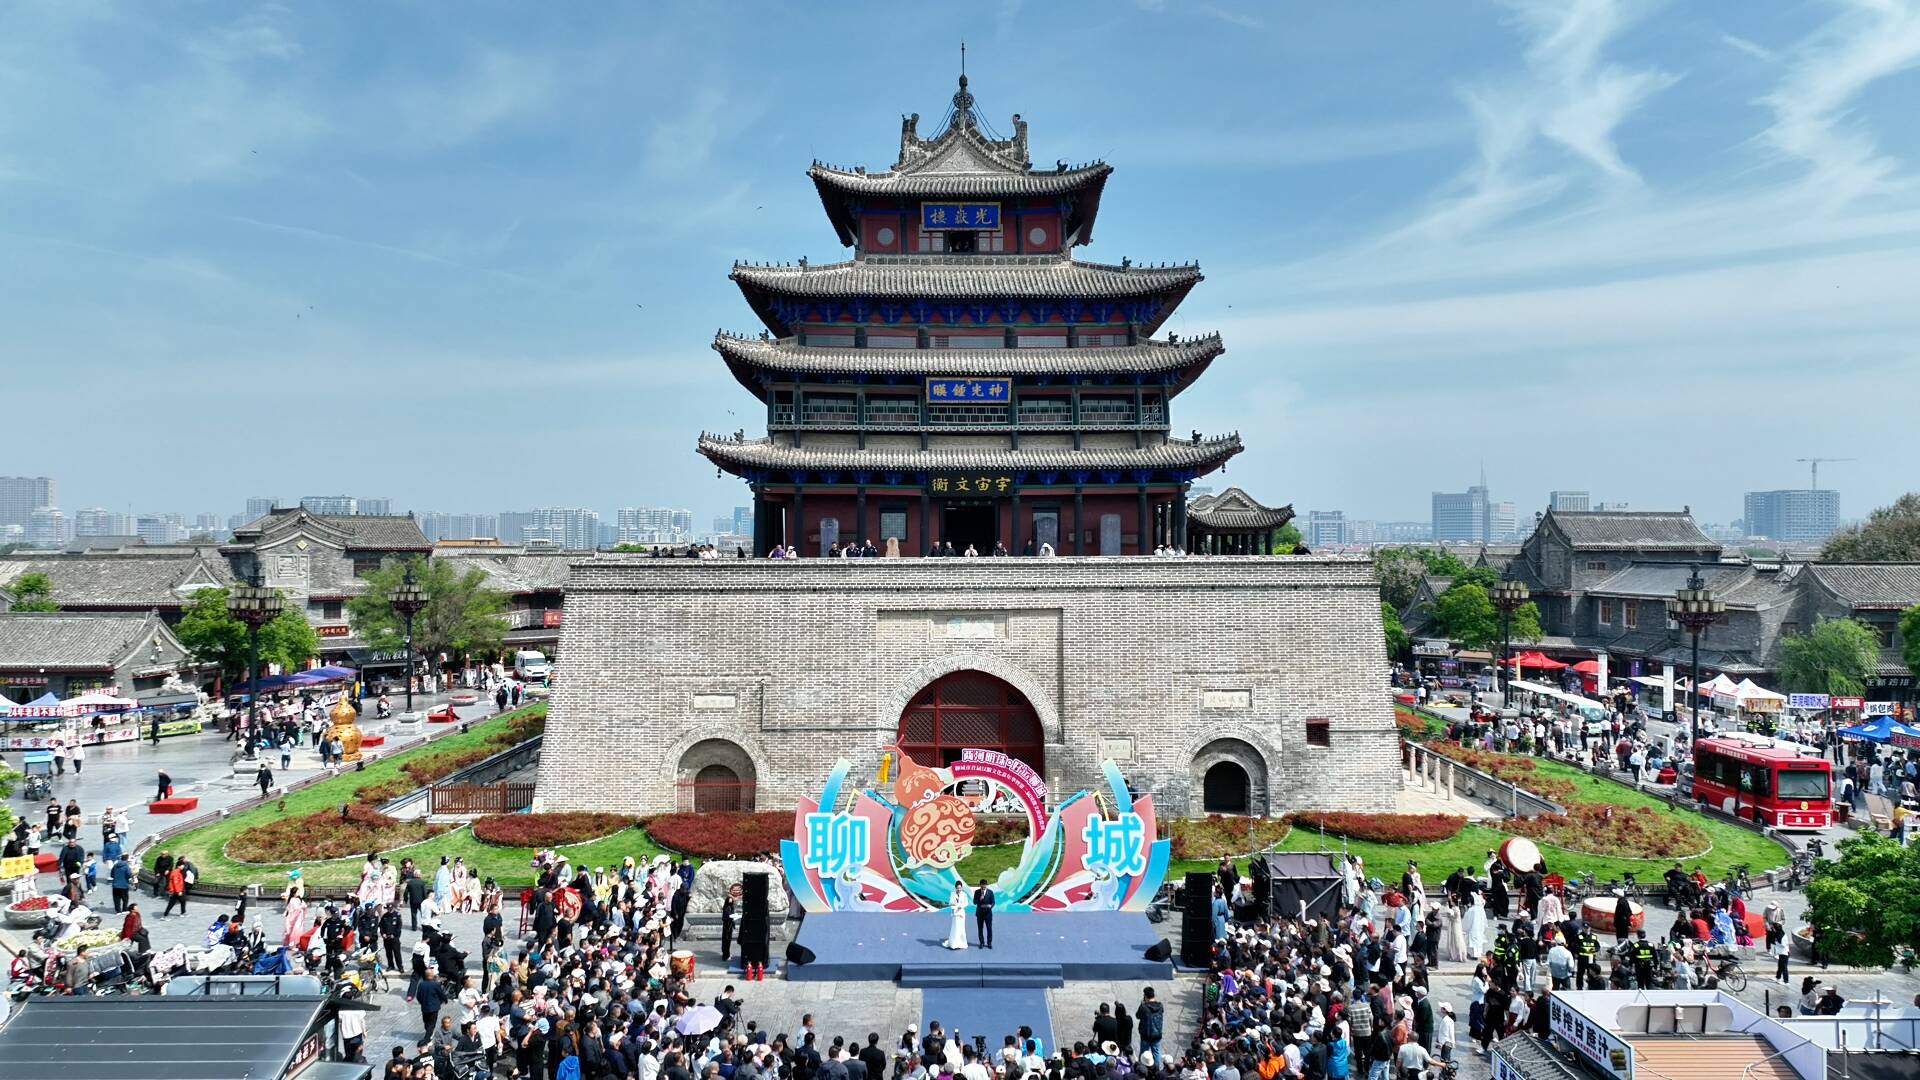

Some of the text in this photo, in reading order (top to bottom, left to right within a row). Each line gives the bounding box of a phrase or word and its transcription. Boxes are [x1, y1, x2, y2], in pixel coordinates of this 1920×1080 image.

[807, 815, 866, 873] 聊
[1085, 815, 1143, 871] 城
[1551, 1001, 1609, 1059] 鲜榨甘蔗汁
